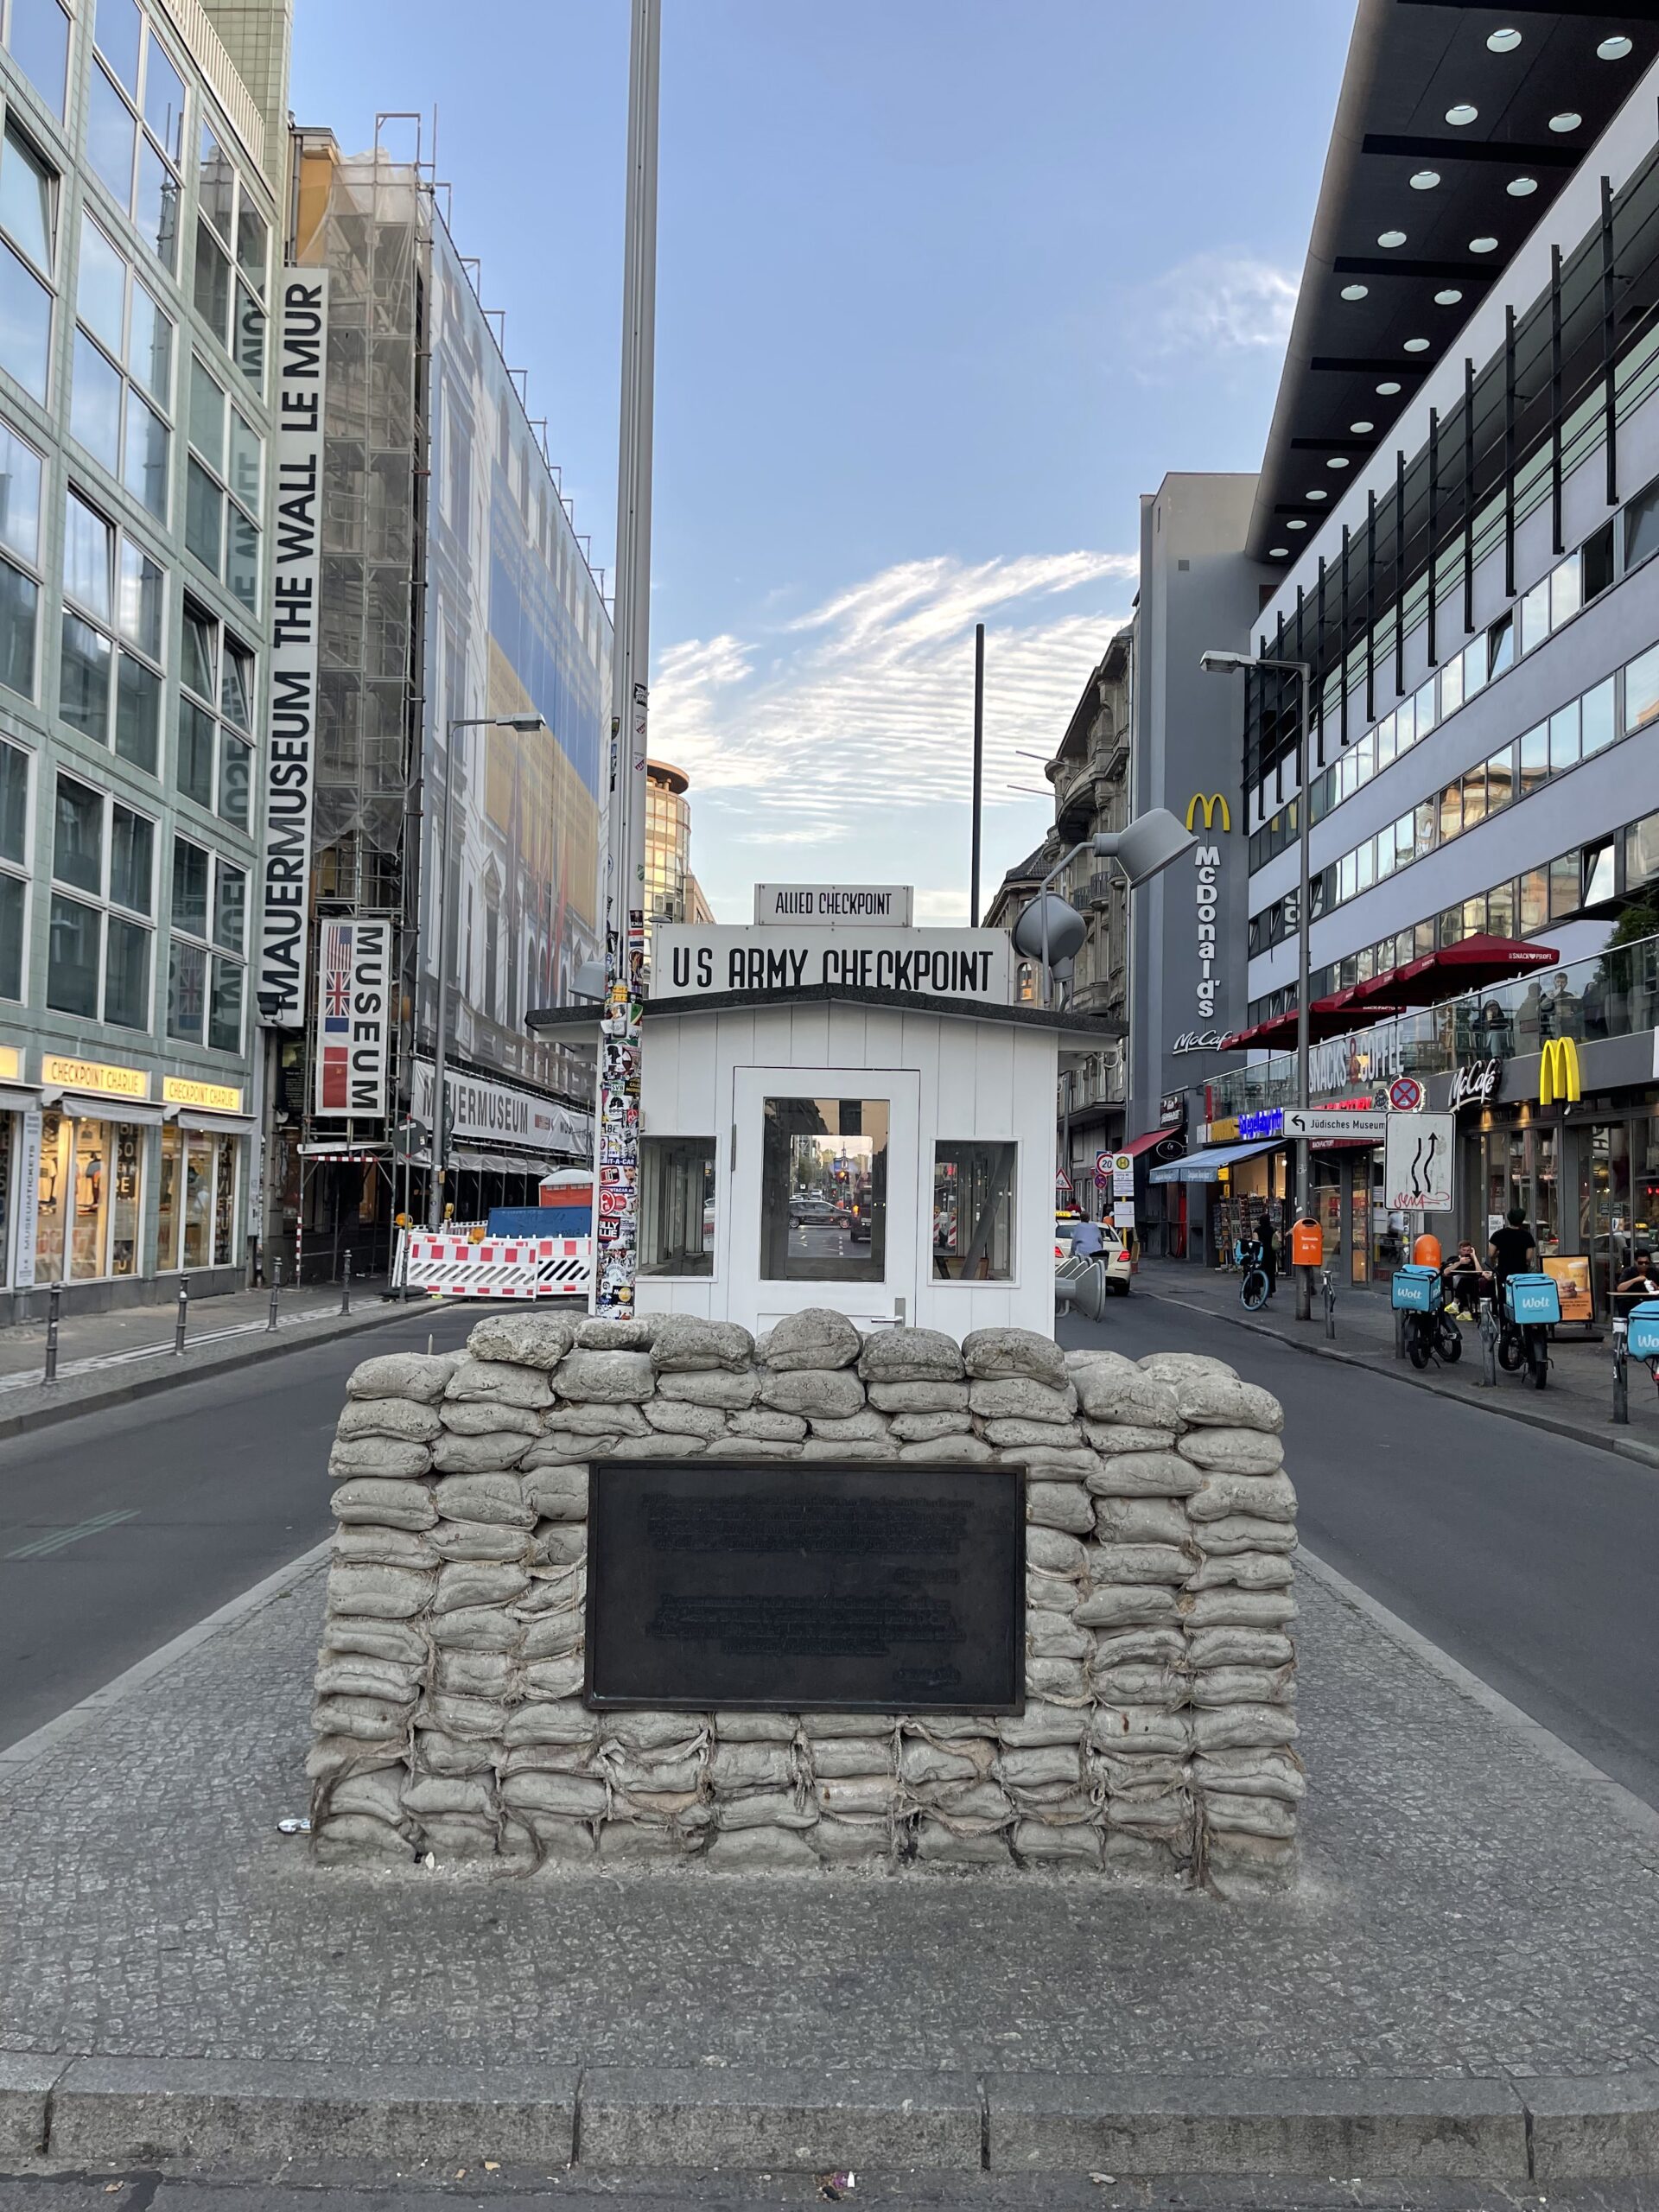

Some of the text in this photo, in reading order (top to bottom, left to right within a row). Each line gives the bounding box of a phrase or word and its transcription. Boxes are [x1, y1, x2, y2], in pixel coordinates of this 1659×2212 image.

[261, 283, 323, 1010] MAUERMUSEUM THE WALL LE MUR
[775, 892, 893, 916] ALLIED CHECKPOINT
[1194, 846, 1221, 1018] McDonald's
[672, 947, 994, 992] US ARMY CHECKPOINT
[352, 926, 384, 1109] MUSEUM
[1172, 1029, 1234, 1052] McCaf
[1308, 1040, 1347, 1094] SNACKS
[1360, 1023, 1404, 1082] COFFEE
[51, 1061, 139, 1093] CHECKPOINT CHARLIE
[1448, 1058, 1496, 1110] McCafé
[169, 1082, 233, 1107] CHECKPOINT CHARLIE
[423, 1076, 529, 1135] MERMUSEUM
[1310, 1119, 1385, 1129] Jüdisches Museum
[1102, 1160, 1112, 1168] 20
[1397, 1288, 1423, 1300] Wolt
[1522, 1297, 1551, 1308] Wolt
[1637, 1334, 1659, 1348] Wo
